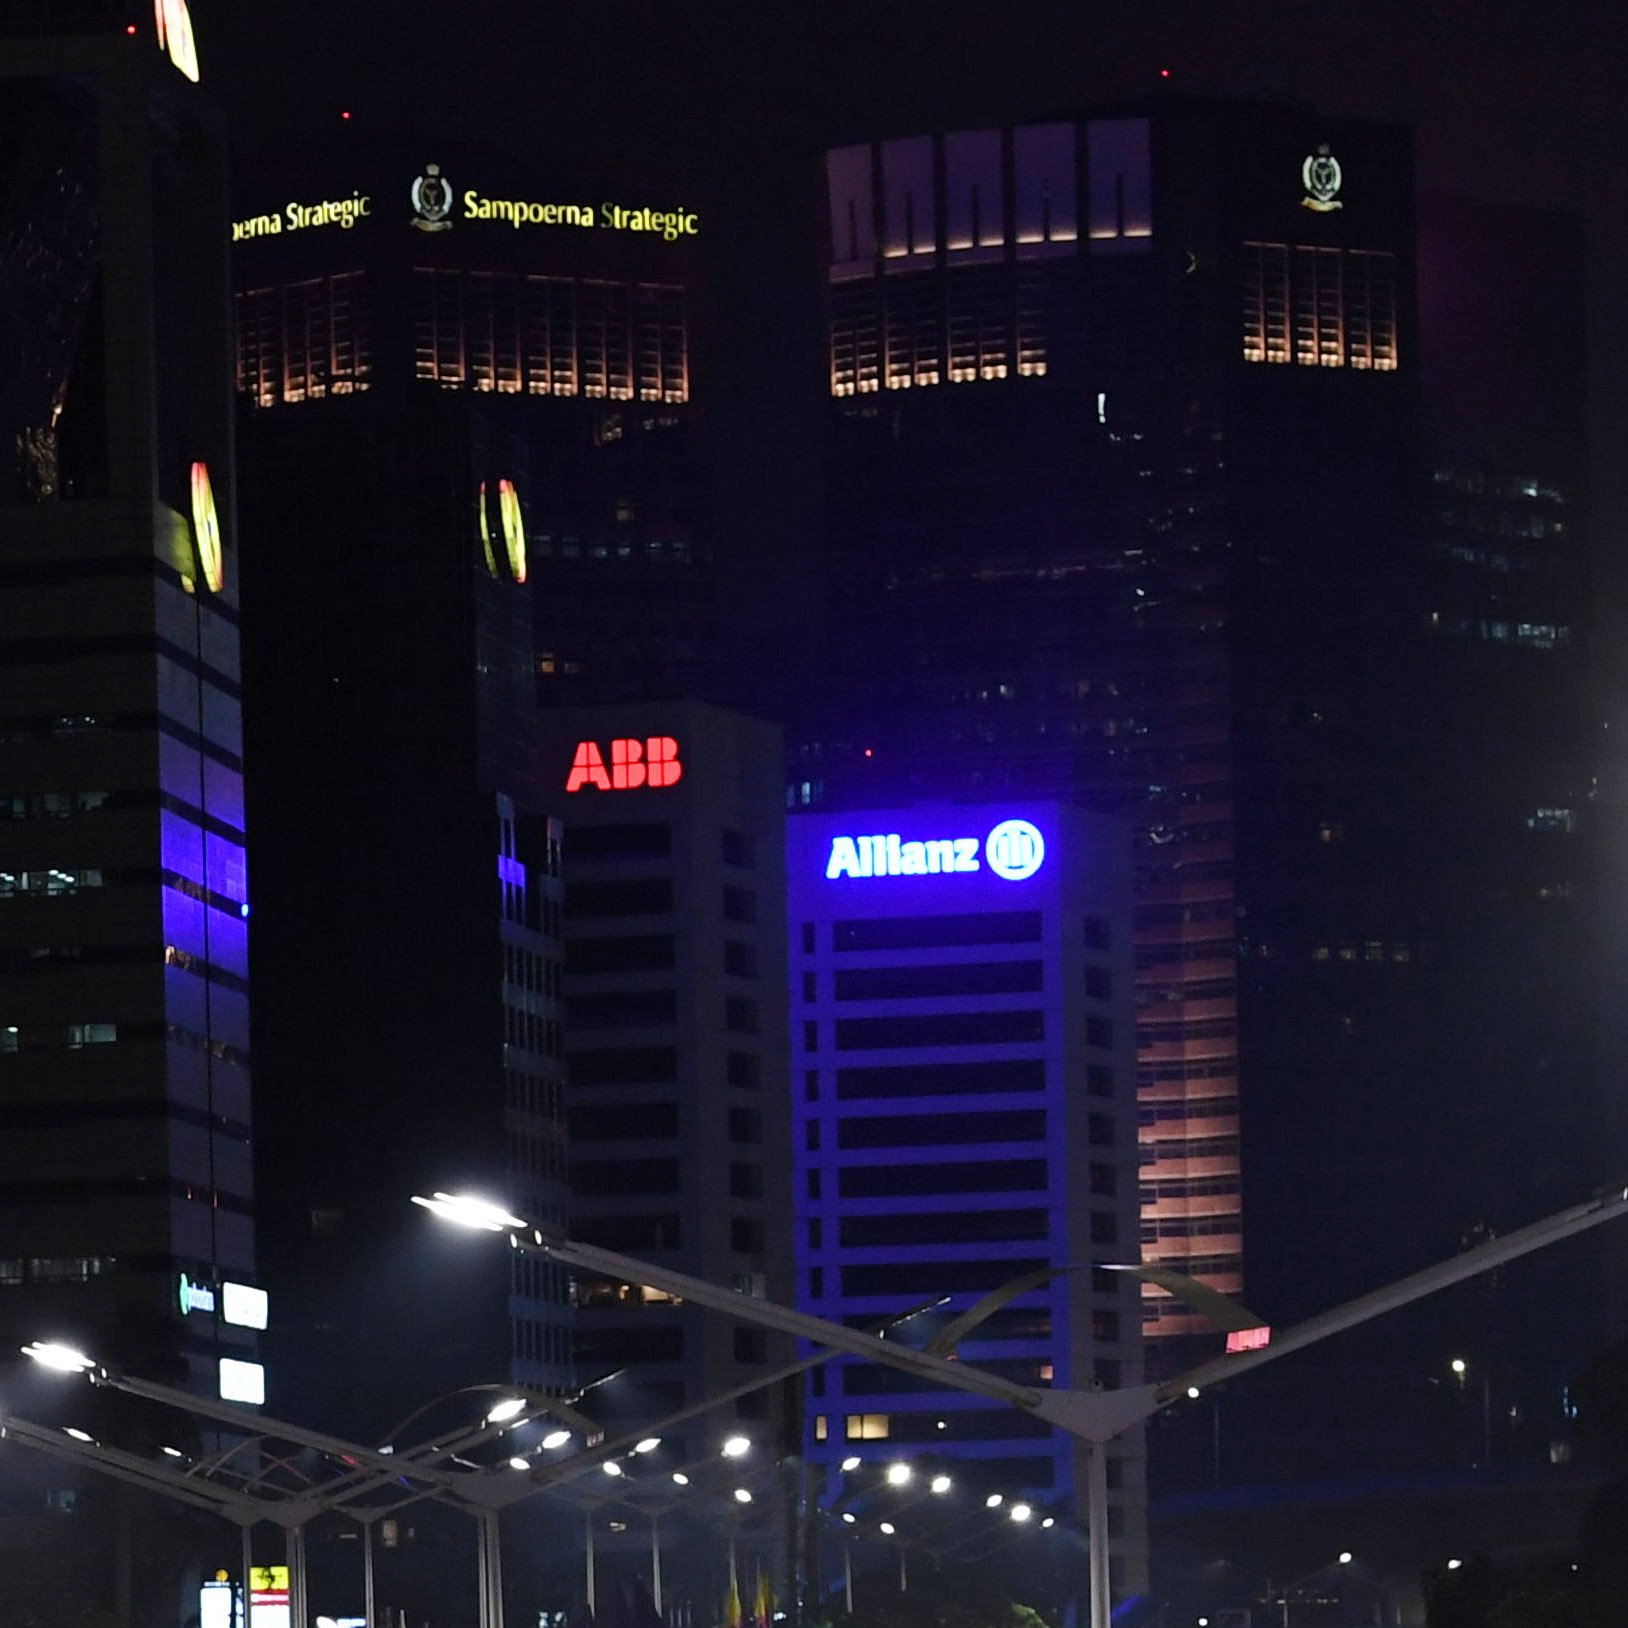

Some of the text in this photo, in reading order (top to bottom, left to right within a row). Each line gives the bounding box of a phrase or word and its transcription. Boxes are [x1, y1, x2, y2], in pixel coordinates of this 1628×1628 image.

[286, 190, 371, 229] Strategic
[464, 190, 699, 241] Sampoerna Strategic
[566, 737, 682, 792] ABB
[826, 834, 979, 879] Allianz
